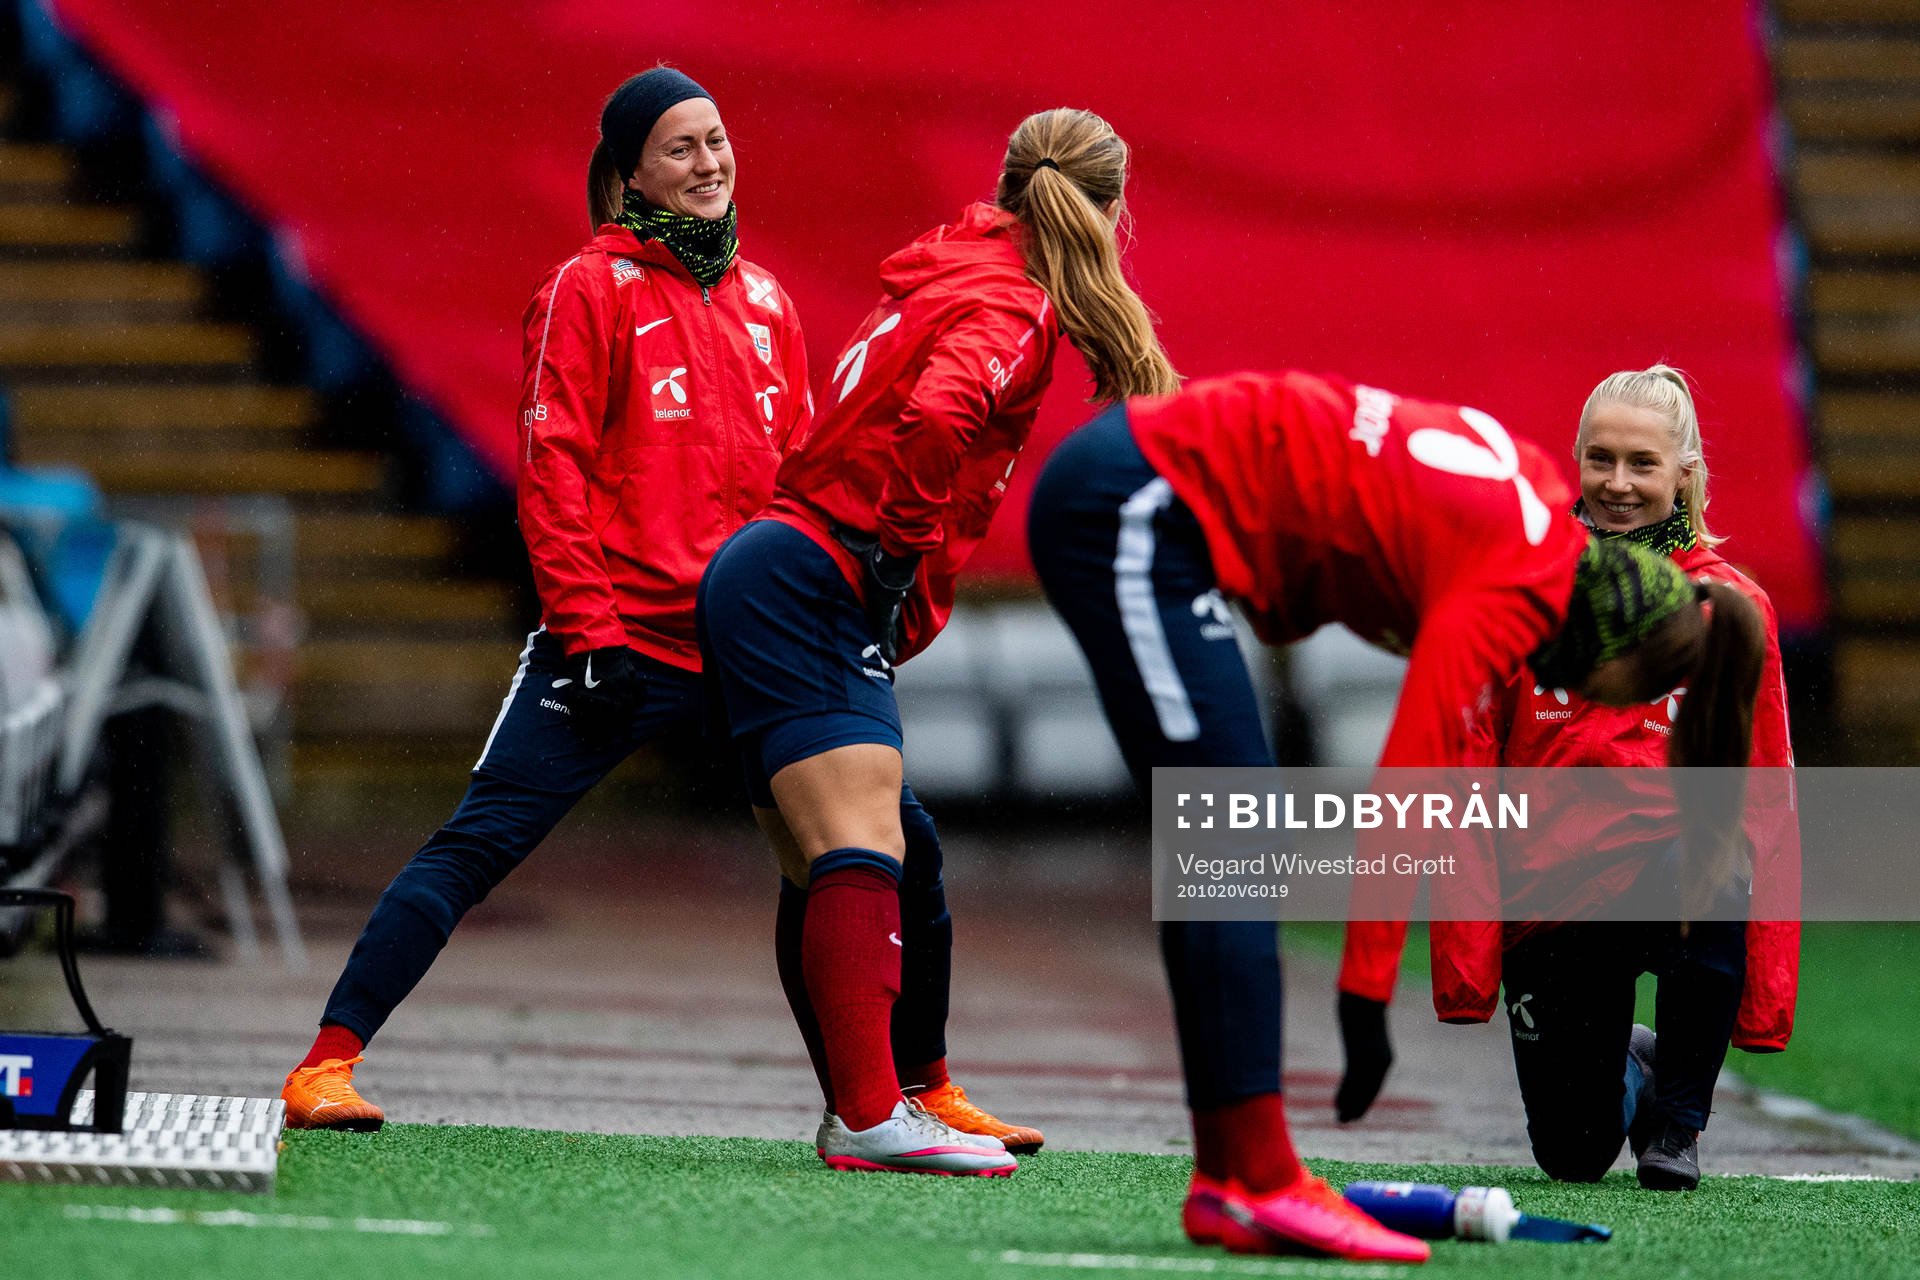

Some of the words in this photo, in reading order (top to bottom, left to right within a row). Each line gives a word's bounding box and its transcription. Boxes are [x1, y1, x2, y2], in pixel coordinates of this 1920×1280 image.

[988, 356, 1013, 388] DN
[655, 408, 691, 419] telenor
[540, 697, 571, 716] telen
[1535, 709, 1572, 720] telenor
[1643, 718, 1673, 735] teleno
